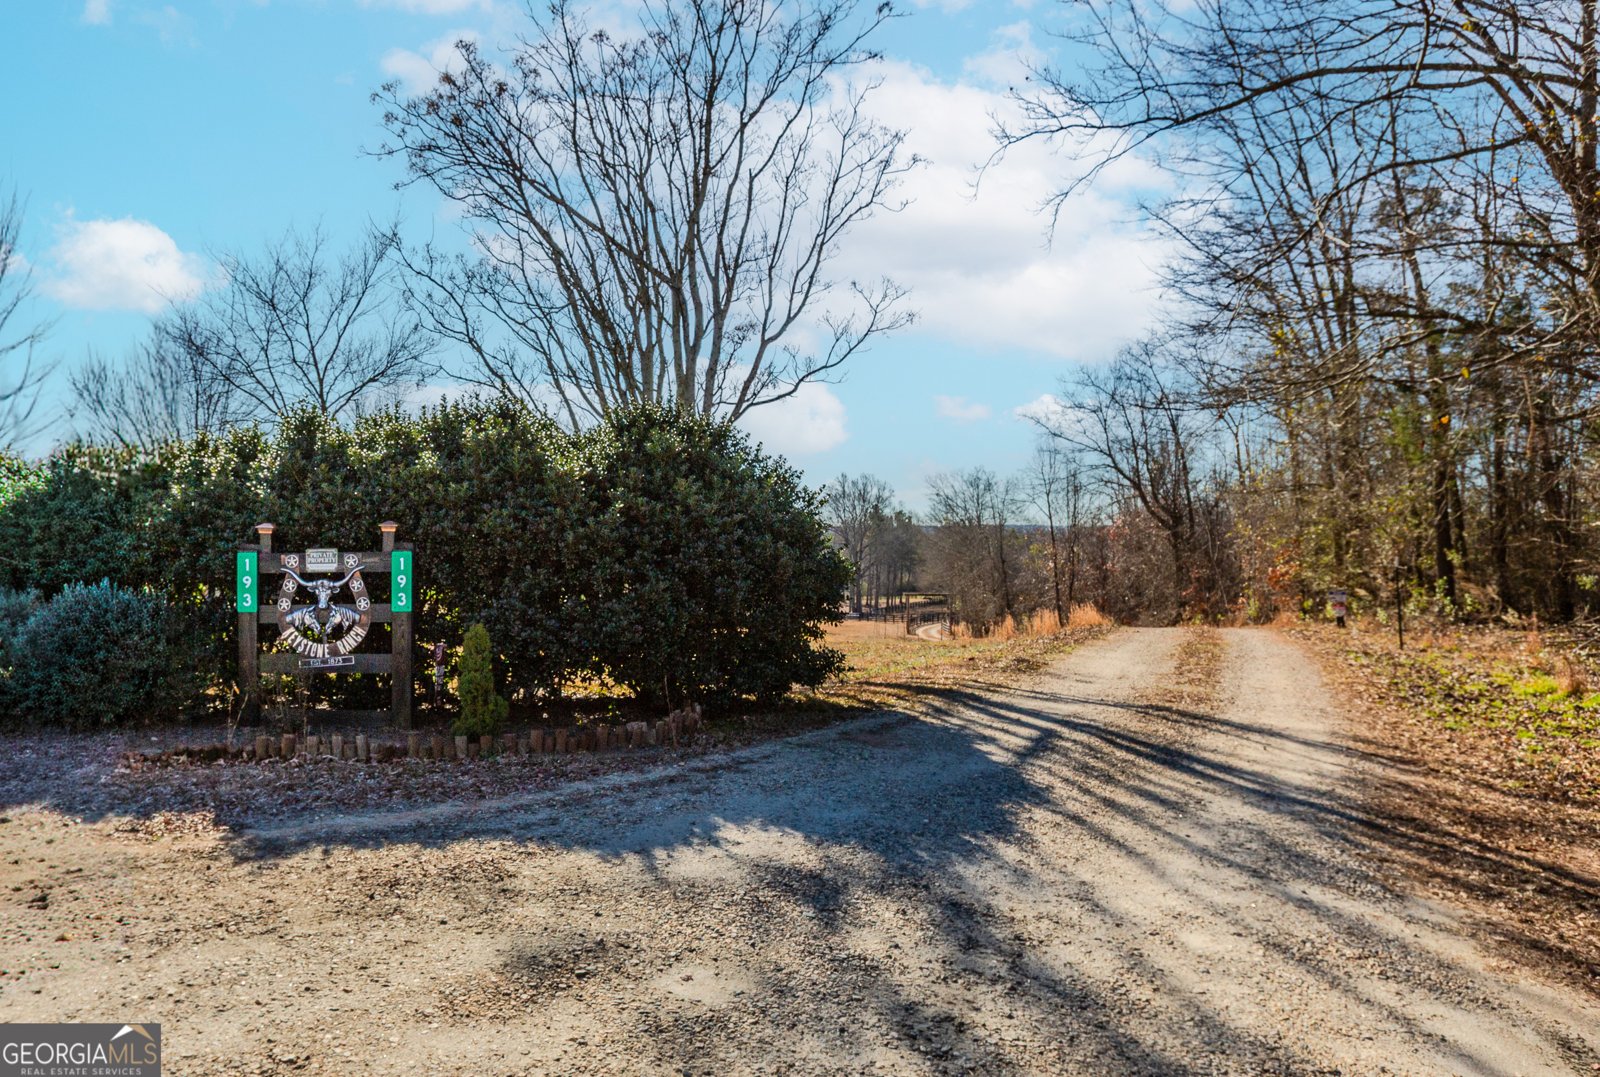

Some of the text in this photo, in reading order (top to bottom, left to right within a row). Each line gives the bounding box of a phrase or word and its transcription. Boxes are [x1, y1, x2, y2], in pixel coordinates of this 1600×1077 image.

[242, 558, 252, 607] 193
[397, 557, 406, 606] 193
[336, 625, 366, 654] RANCH
